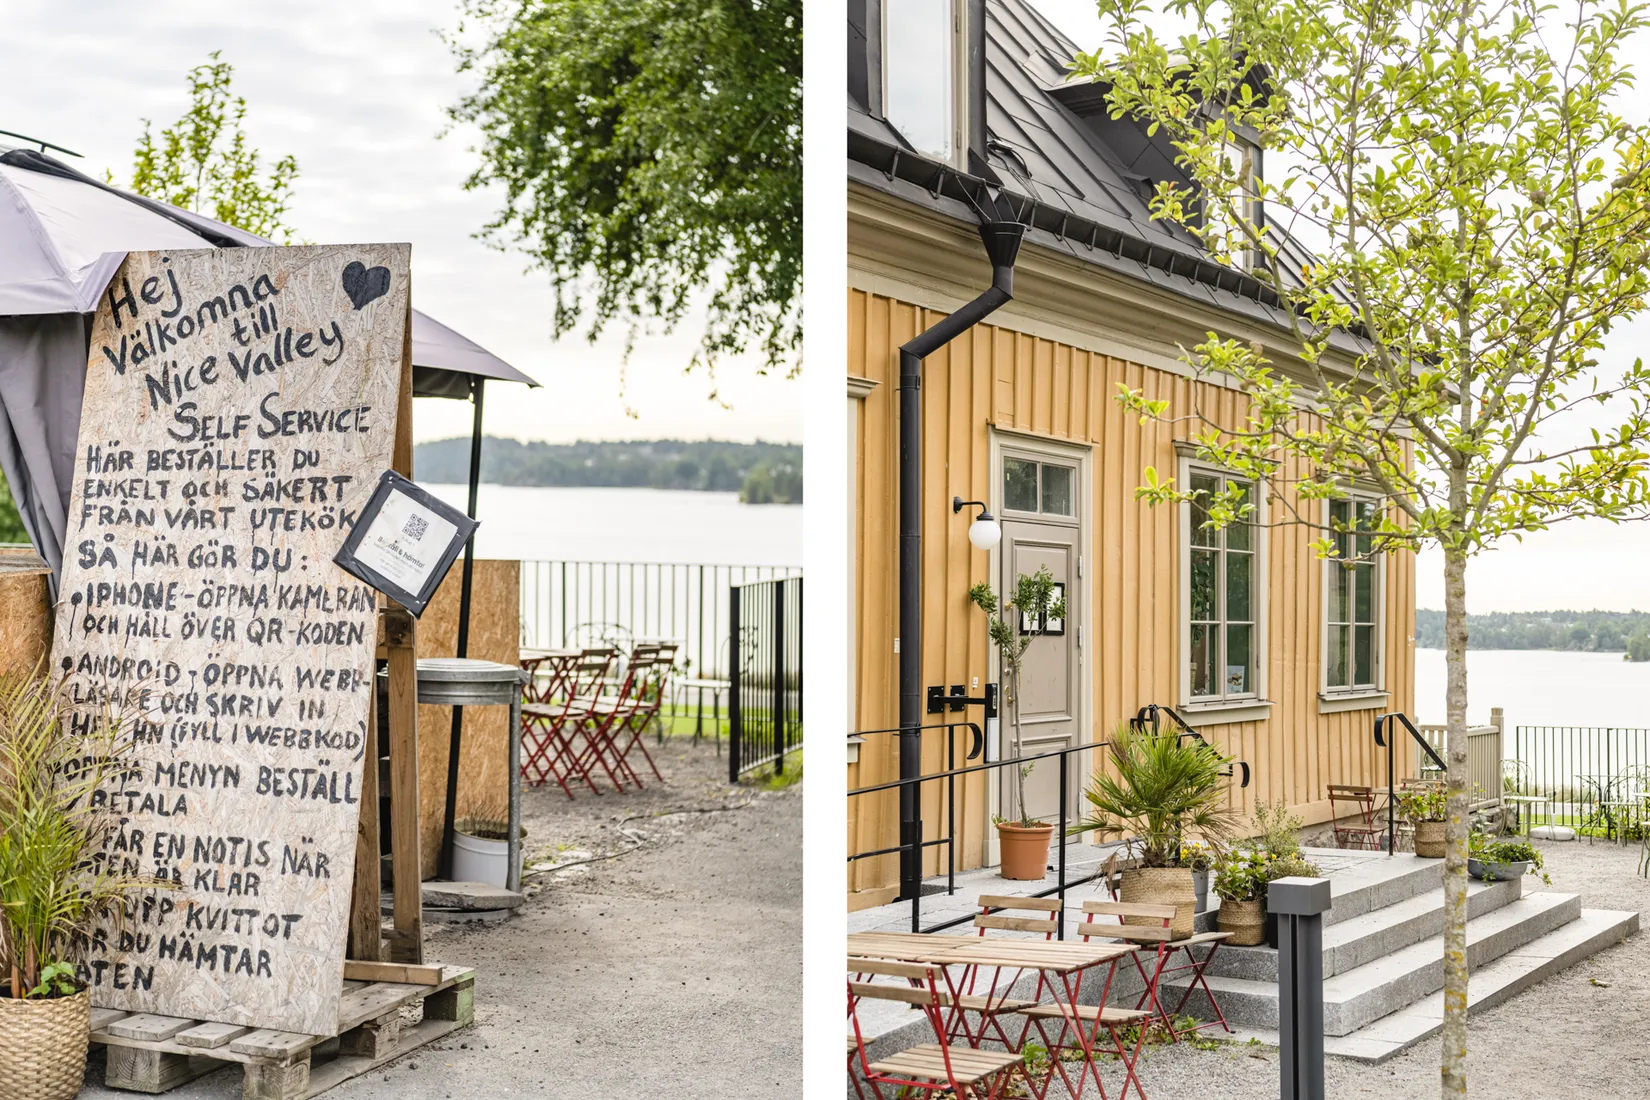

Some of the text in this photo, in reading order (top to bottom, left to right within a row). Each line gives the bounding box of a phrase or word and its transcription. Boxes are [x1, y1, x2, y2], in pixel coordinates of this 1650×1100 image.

[108, 257, 183, 328] Hej
[103, 274, 279, 375] Välkomna
[233, 302, 277, 346] till
[146, 321, 344, 411] Nice Valley
[167, 392, 371, 443] SELF SERVICE
[87, 440, 320, 472] HÄR BESTÄLLER DU
[83, 469, 353, 501] ENKELT OCH SÄKERT
[80, 499, 356, 532] FRÅN VÅRT UTEKÖK
[78, 533, 117, 570] SÅ
[132, 535, 179, 568] HÄR
[187, 540, 237, 569] GÖR
[277, 584, 377, 614] KAMERAN
[83, 613, 118, 636] OCH
[126, 611, 171, 641] HÅLL
[181, 613, 235, 641] ÖVER
[74, 679, 325, 721] LÄSAE OCH SKRIV IN
[232, 723, 237, 745] I
[155, 761, 240, 789] MENYN
[256, 759, 359, 804] BESTÄLL
[102, 818, 145, 856] FÅR
[153, 832, 185, 859] EN
[193, 836, 271, 868] NOTIS
[281, 837, 331, 879] NÄR
[194, 868, 260, 897] KLAR
[186, 902, 304, 940] KVITTOT
[119, 929, 151, 954] DU
[159, 930, 272, 977] HÄMTAR
[74, 959, 155, 991] ATEN
